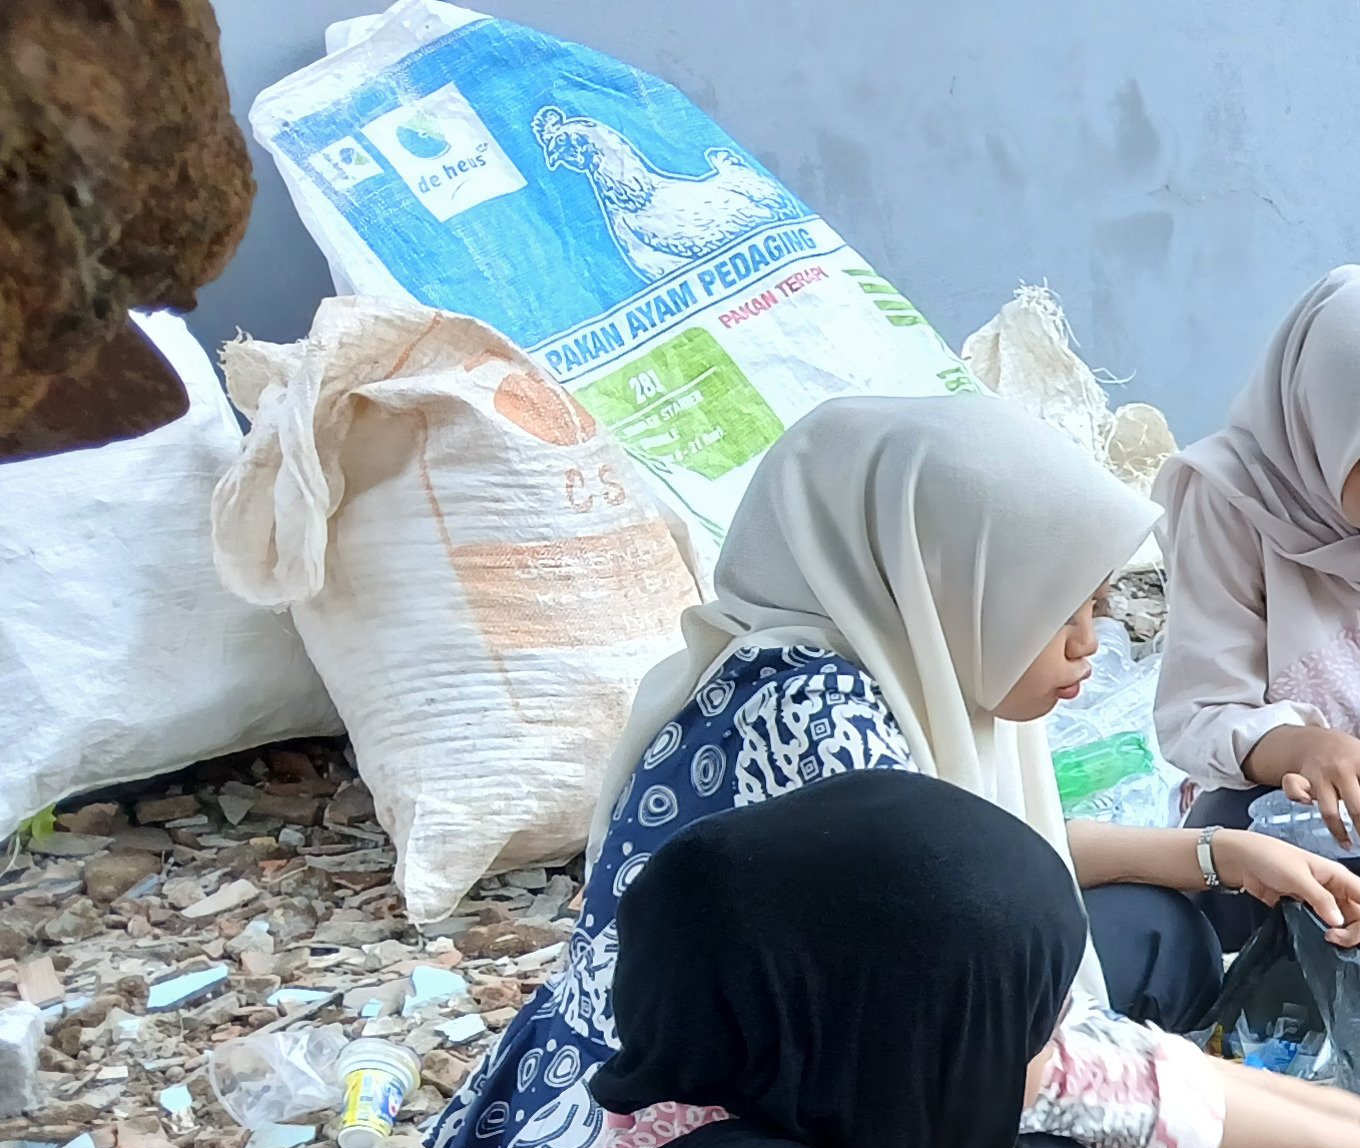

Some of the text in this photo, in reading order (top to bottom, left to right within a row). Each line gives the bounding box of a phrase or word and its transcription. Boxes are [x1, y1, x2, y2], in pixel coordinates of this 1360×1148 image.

[418, 155, 488, 193] de heus
[545, 227, 817, 375] PAKAN AYAM PEDAGING
[717, 265, 830, 329] PAKAN TERAPI
[628, 368, 665, 405] 281
